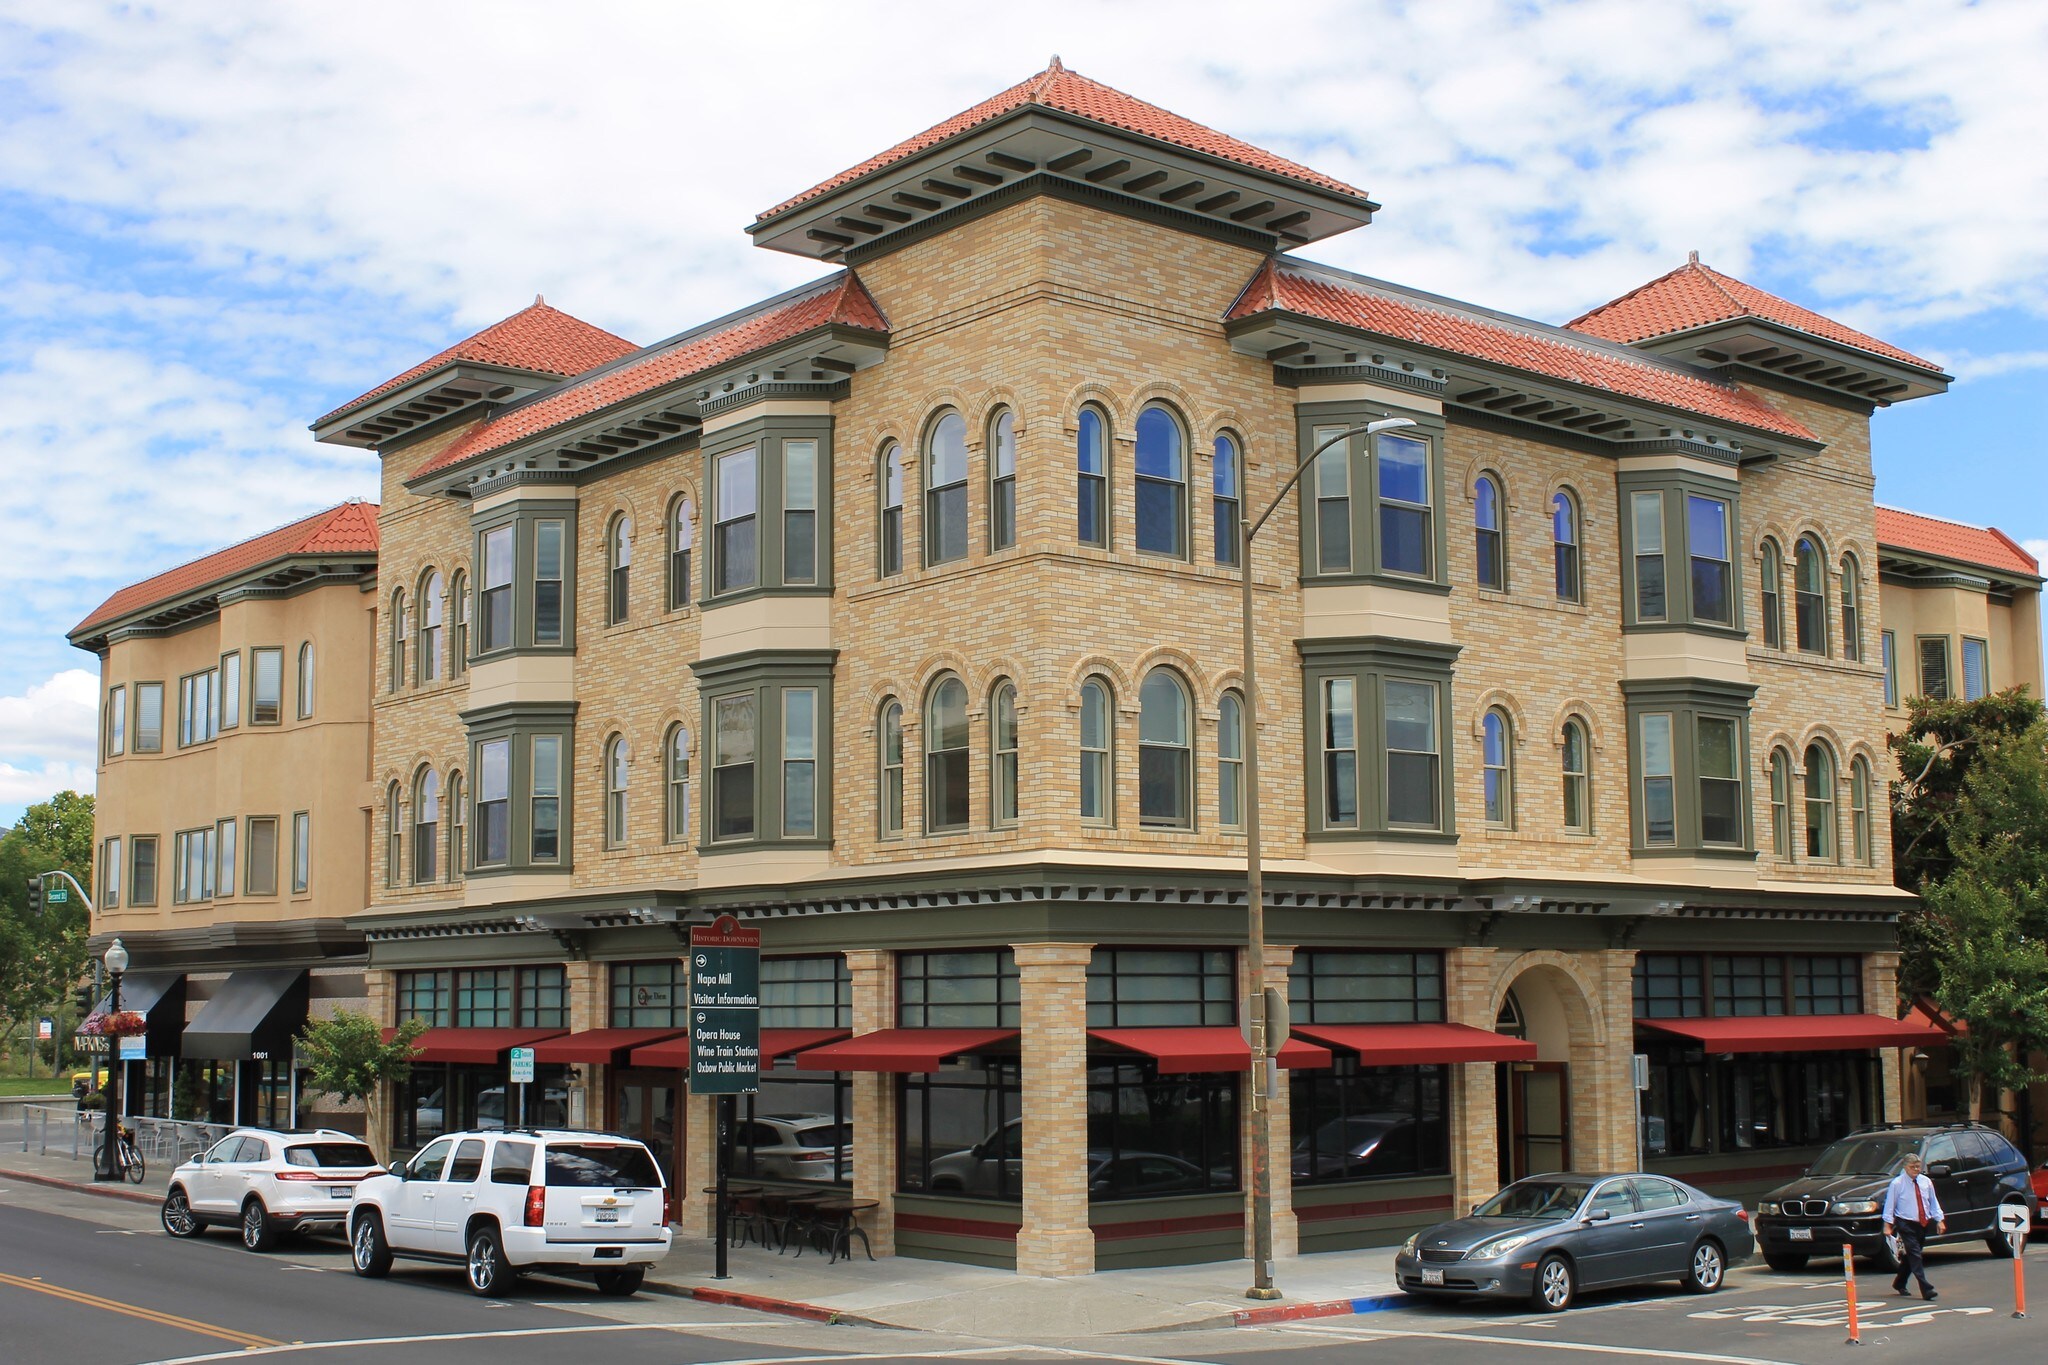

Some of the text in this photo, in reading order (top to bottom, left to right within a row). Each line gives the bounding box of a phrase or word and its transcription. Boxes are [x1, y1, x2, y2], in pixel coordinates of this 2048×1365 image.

[697, 972, 732, 987] Napa Mill
[693, 992, 758, 1005] Visitor Information
[696, 1028, 741, 1042] Opera House
[252, 1051, 268, 1060] 1001
[513, 1050, 520, 1058] 2
[697, 1045, 759, 1057] Wine Train Station
[697, 1061, 757, 1073] Oxbow Public Market
